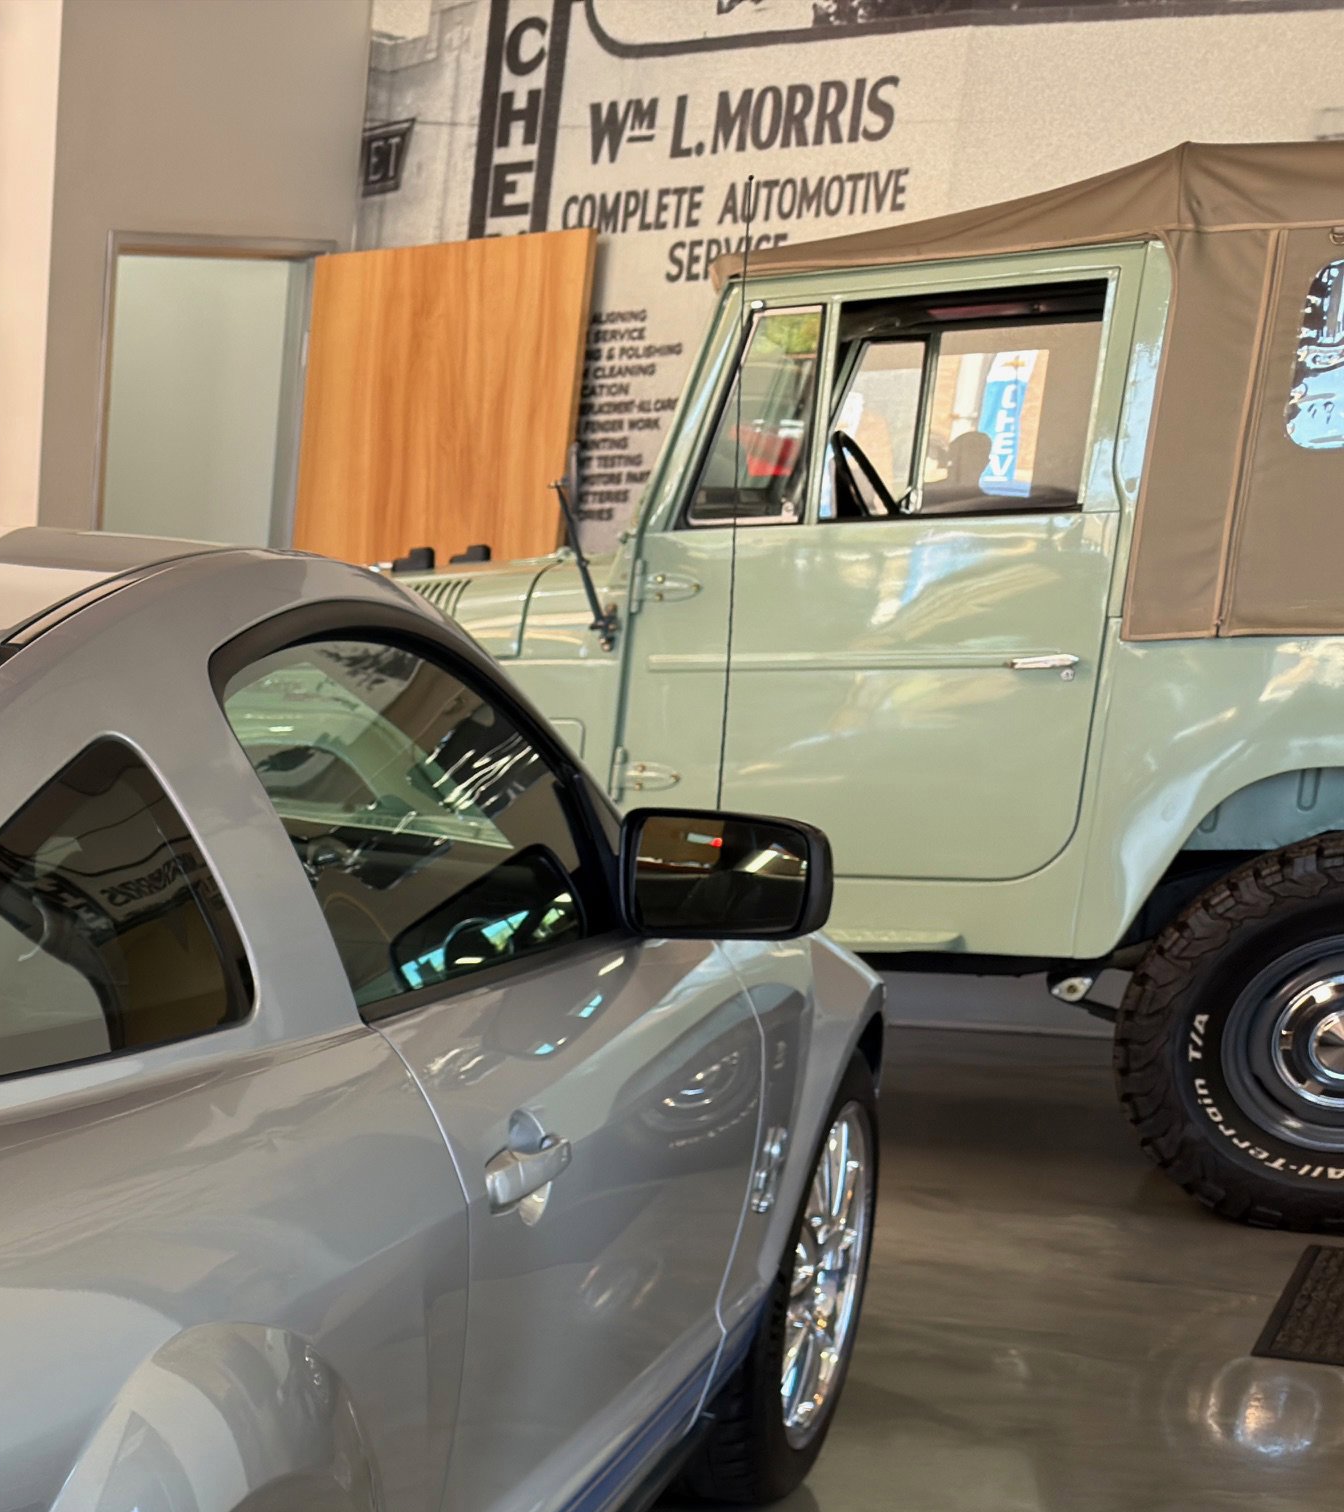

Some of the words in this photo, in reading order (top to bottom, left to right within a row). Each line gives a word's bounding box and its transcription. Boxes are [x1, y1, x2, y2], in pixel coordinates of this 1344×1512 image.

[484, 17, 548, 238] CHE
[711, 75, 900, 155] MORRIS
[562, 185, 704, 234] COMPLETE
[717, 167, 910, 225] AUTOMOTIVE
[1187, 1013, 1211, 1064] T/A
